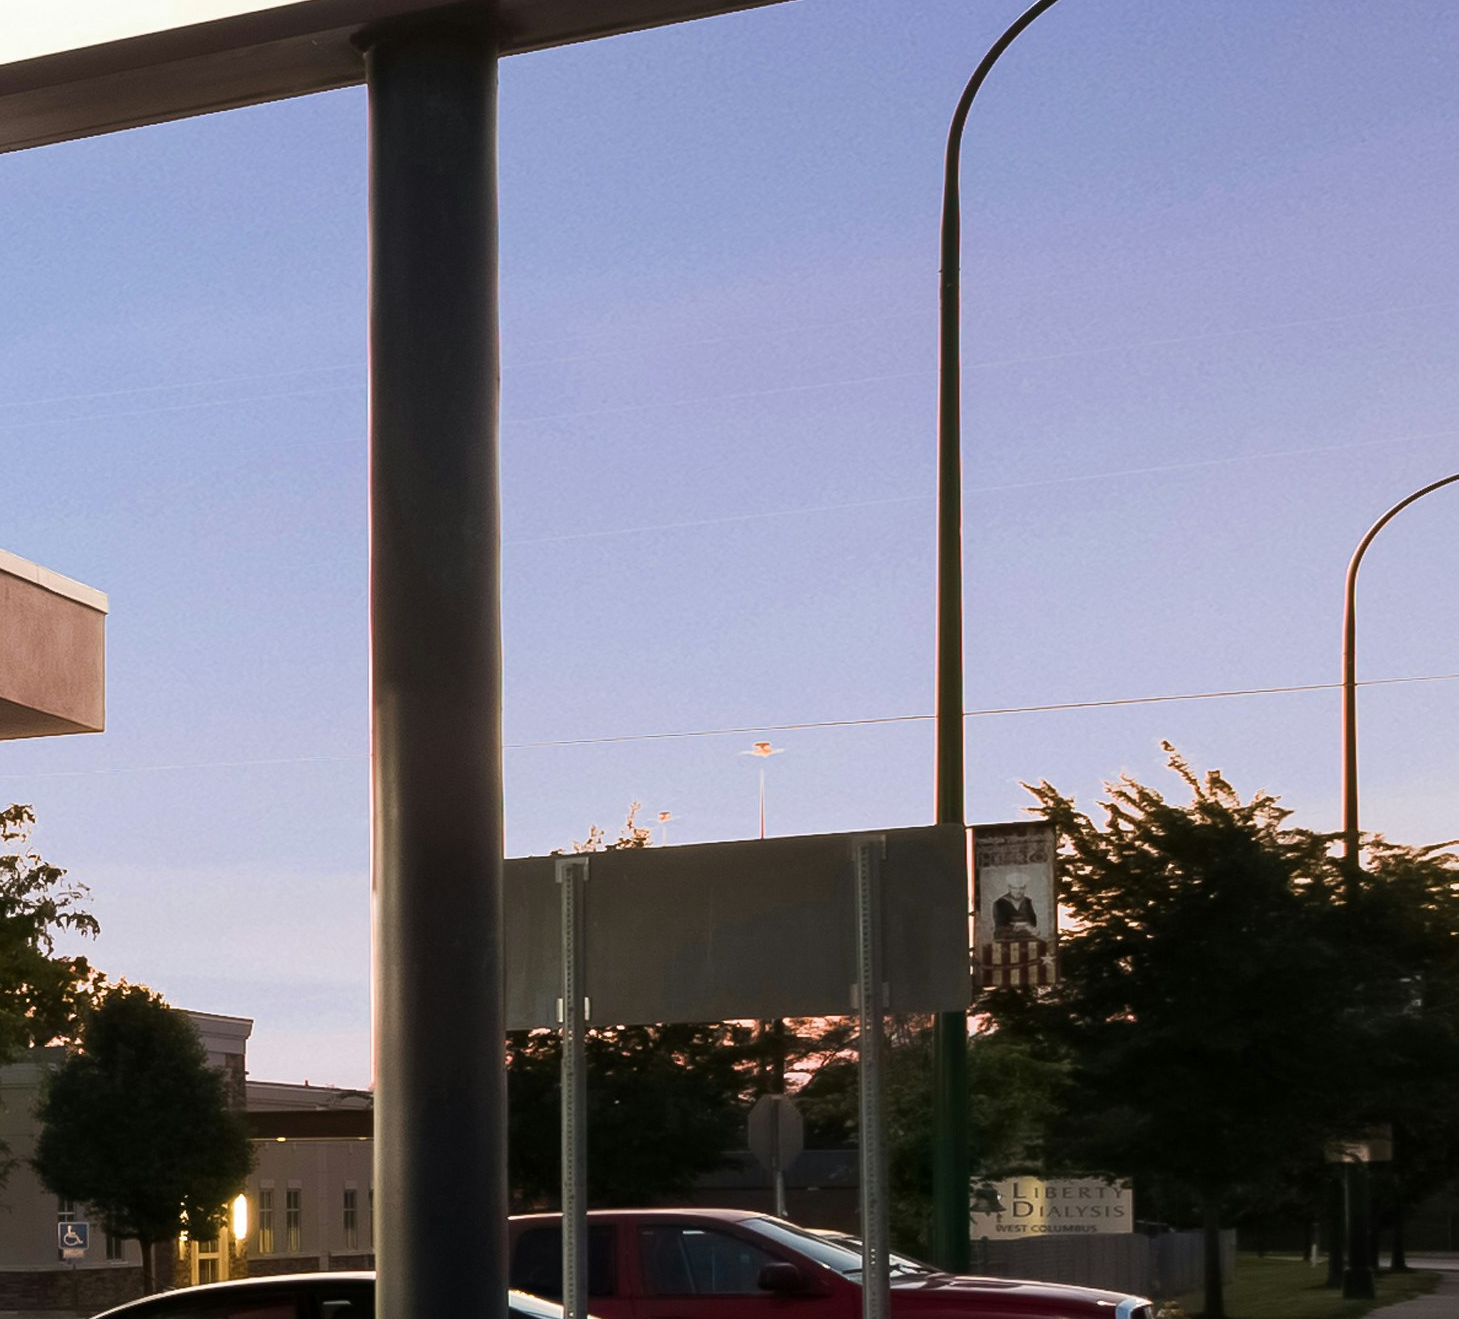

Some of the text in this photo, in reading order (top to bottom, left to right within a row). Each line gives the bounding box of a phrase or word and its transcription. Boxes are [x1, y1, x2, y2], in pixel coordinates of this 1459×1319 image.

[1012, 1183, 1123, 1199] LIBERTY
[1012, 1200, 1125, 1218] DIALYSIS
[1030, 1224, 1098, 1233] COLUMBUS
